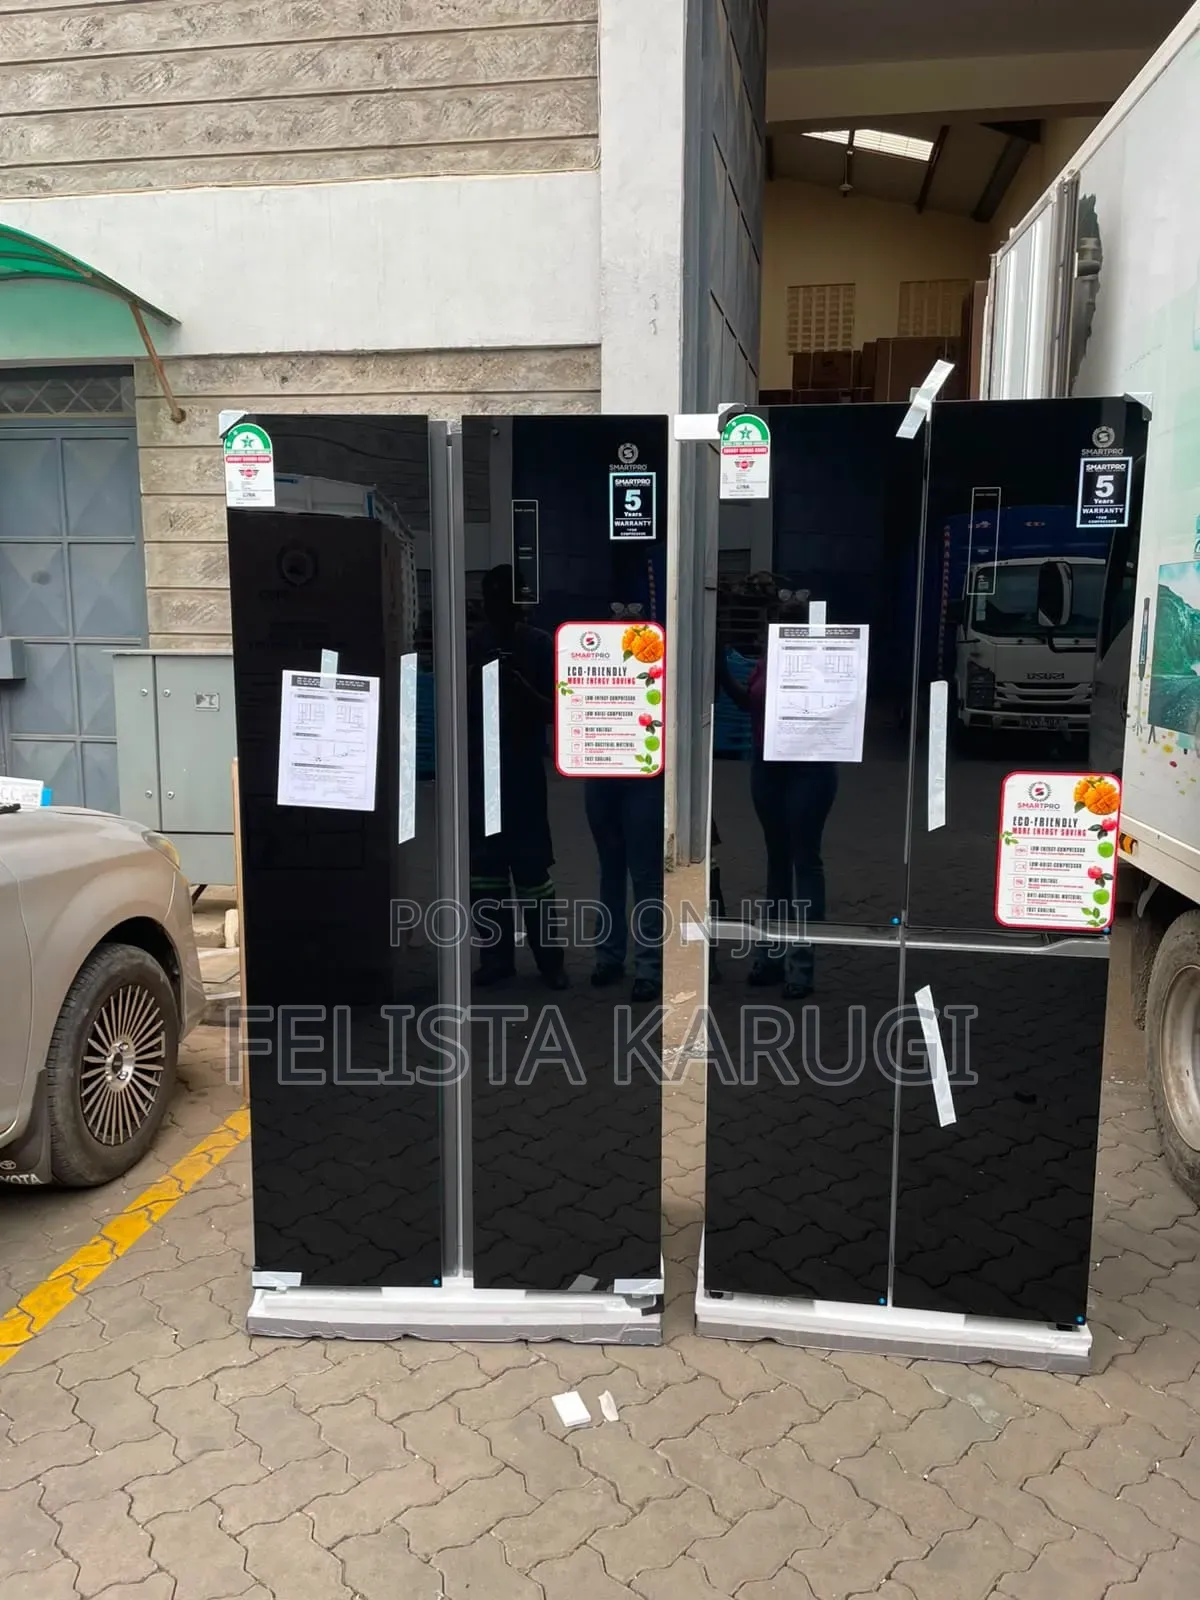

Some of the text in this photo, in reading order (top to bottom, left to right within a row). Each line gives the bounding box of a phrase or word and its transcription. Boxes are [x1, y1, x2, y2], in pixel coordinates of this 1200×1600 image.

[1095, 475, 1114, 498] 5
[624, 489, 642, 511] 5
[567, 666, 628, 677] ECO-FRIENDLY
[567, 677, 636, 685] MORE ENERGY SAVING
[1013, 815, 1078, 828] ECO-FRIENDLY
[1012, 827, 1031, 835] MORE
[1033, 828, 1058, 836] ENERGY
